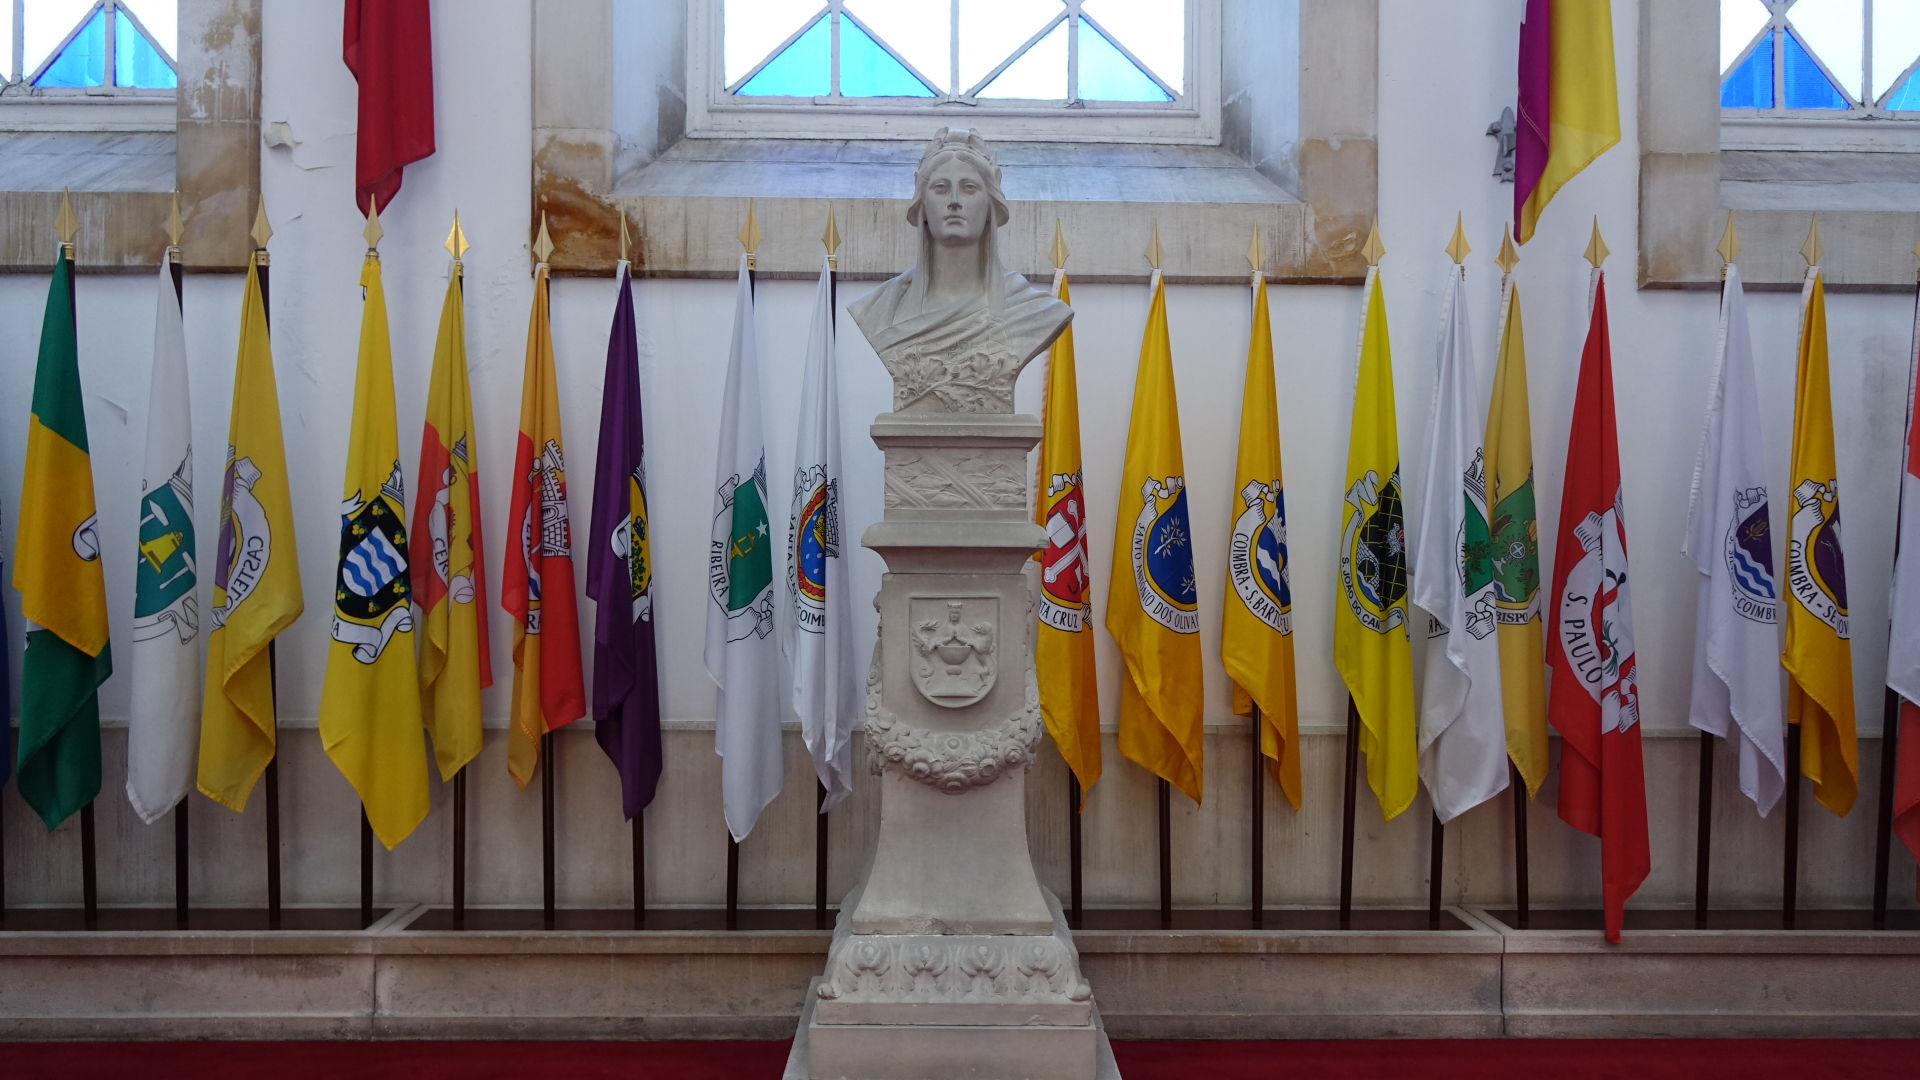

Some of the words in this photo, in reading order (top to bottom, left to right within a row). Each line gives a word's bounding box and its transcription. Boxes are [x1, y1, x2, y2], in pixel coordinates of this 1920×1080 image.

[787, 513, 796, 561] SANTA
[1232, 532, 1251, 586] COIMBRA
[710, 540, 730, 598] RIBEIRA
[1134, 522, 1146, 560] SANTO
[1152, 601, 1174, 624] DOS
[1341, 557, 1350, 568] S.
[1351, 600, 1362, 616] DO
[1789, 539, 1819, 605] COIMBRA
[1052, 610, 1078, 629] CRUZ
[1565, 591, 1589, 608] S.
[1564, 618, 1603, 684] PAULO
